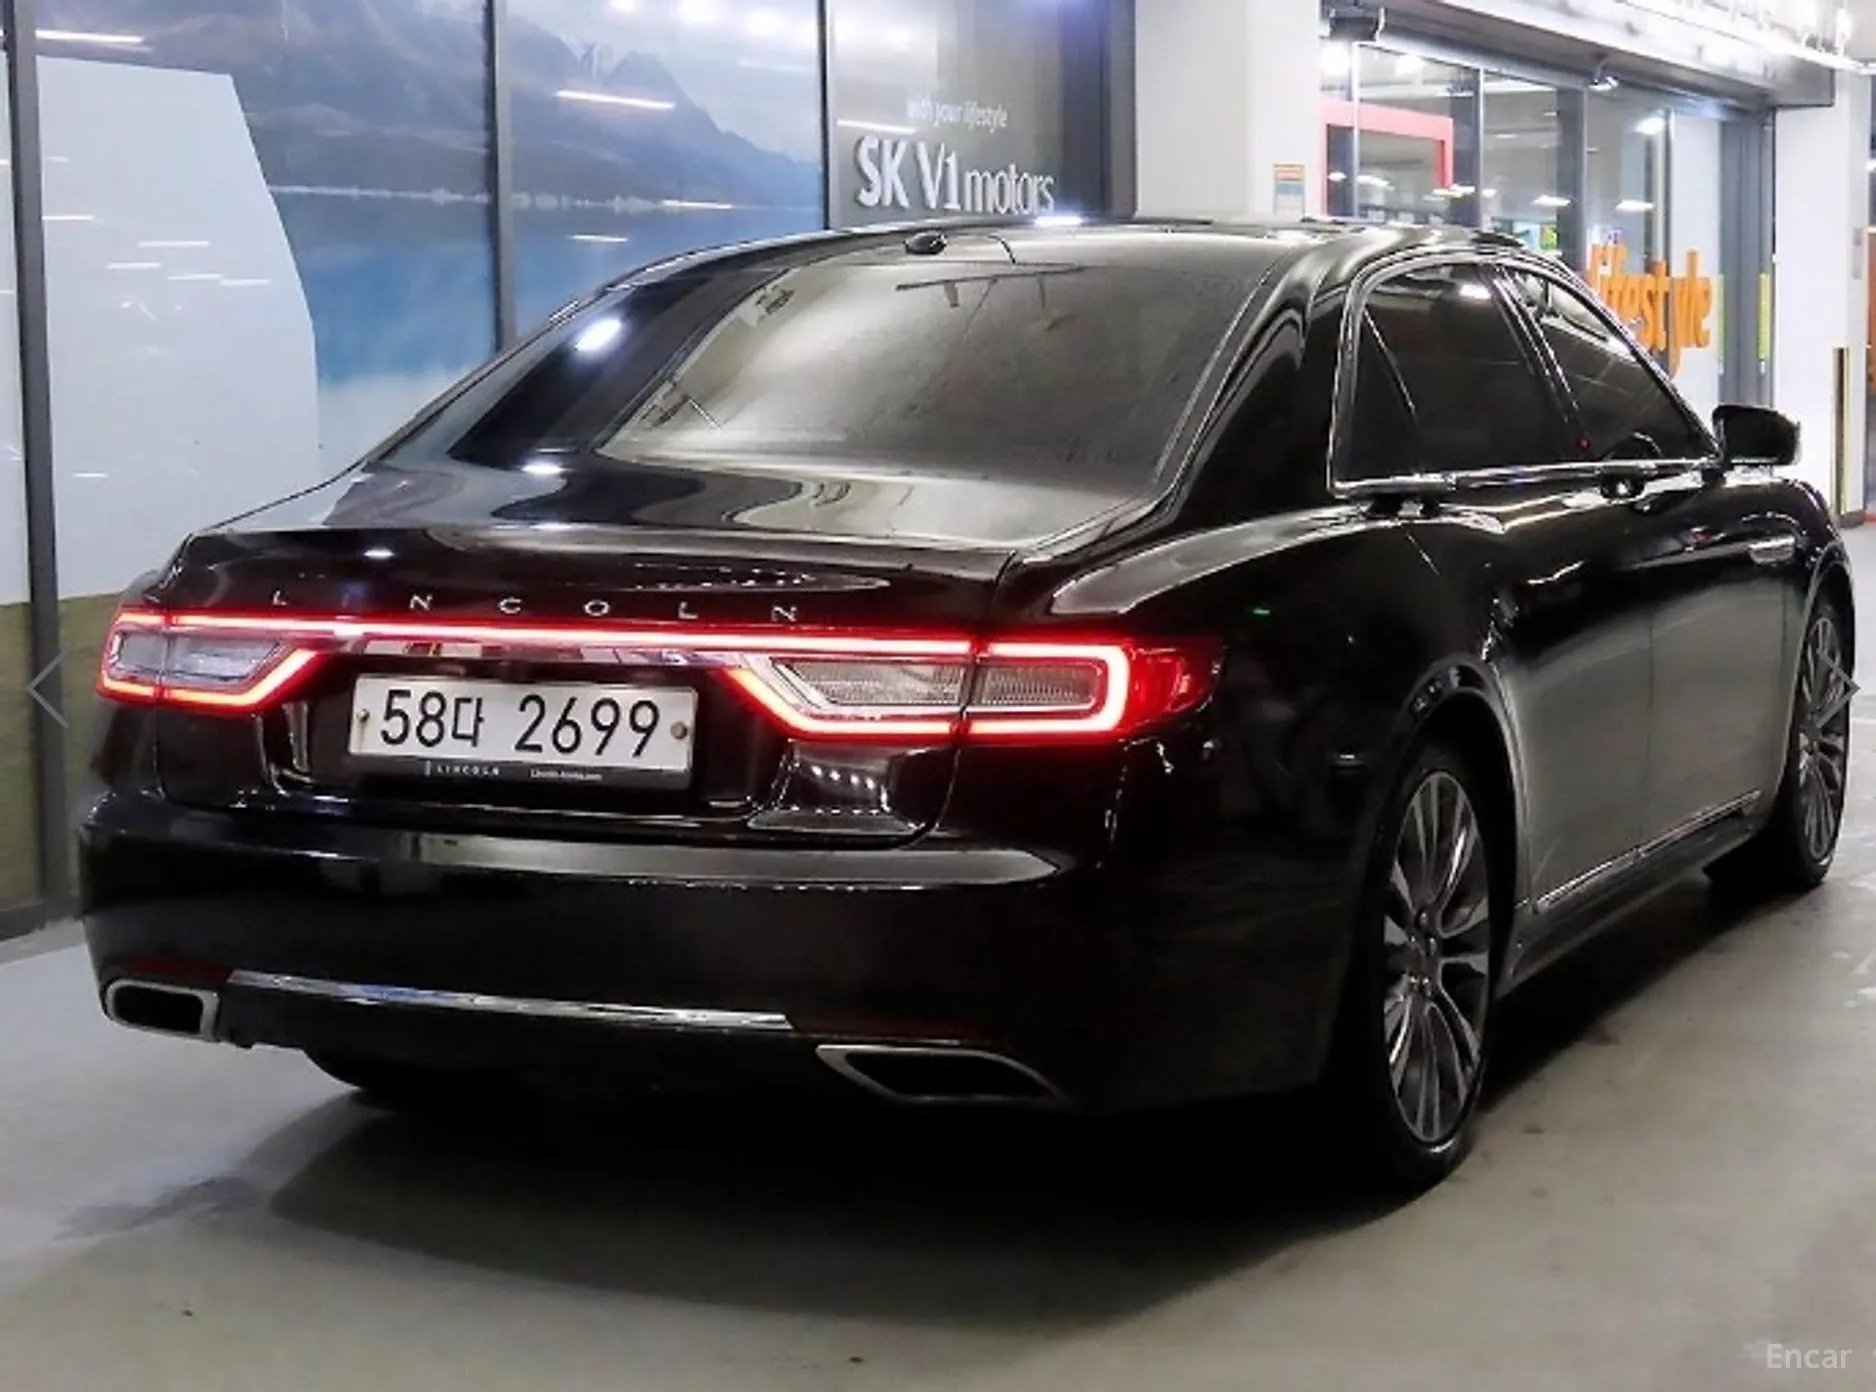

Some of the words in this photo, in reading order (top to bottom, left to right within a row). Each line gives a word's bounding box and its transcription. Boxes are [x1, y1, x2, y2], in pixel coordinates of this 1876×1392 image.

[933, 103, 963, 128] your
[964, 100, 1008, 134] lifestyle
[857, 134, 910, 208] SK
[513, 694, 661, 758] 2699
